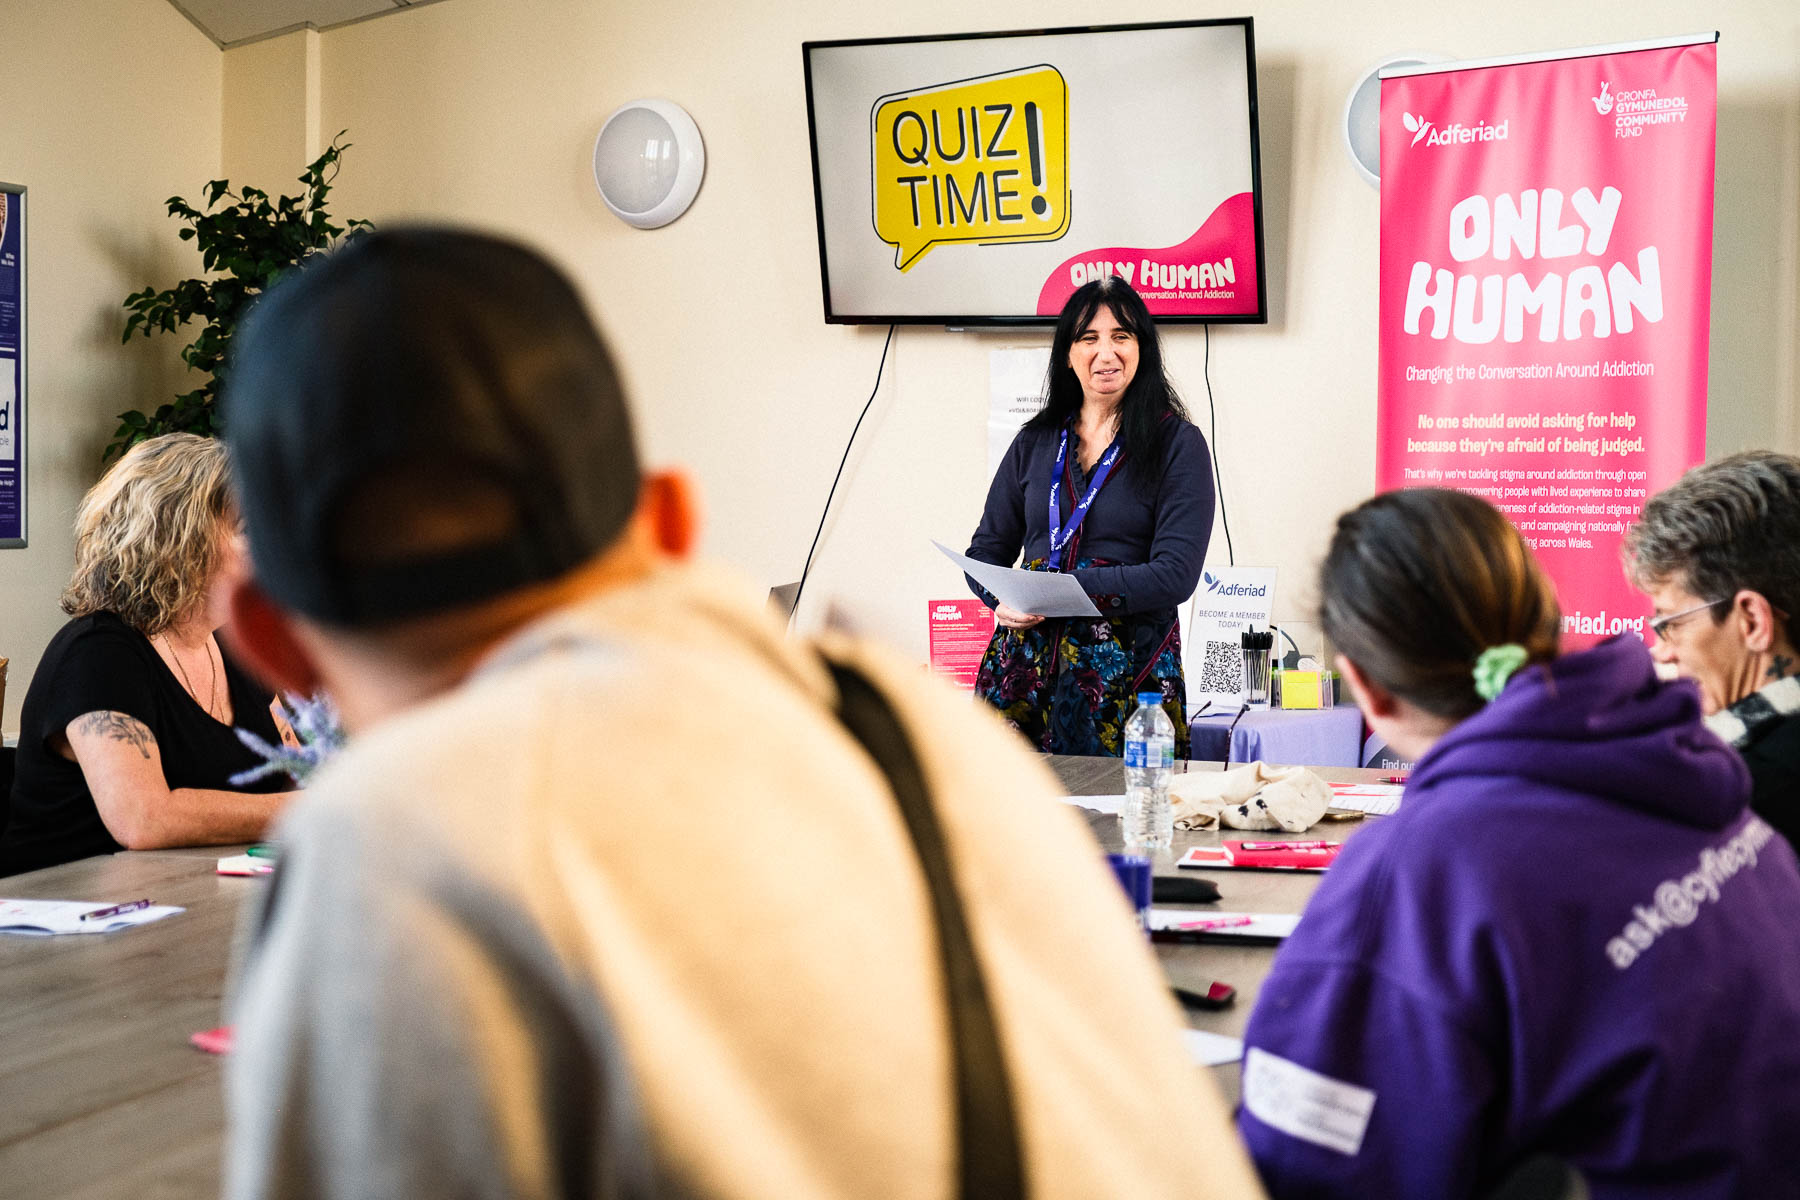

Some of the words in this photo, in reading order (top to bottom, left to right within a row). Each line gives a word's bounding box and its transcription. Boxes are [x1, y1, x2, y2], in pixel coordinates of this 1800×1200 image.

[1616, 89, 1656, 102] CRONFA
[1616, 97, 1688, 113] GYMUNEDOL
[1616, 111, 1687, 127] COMMUNITY
[892, 103, 1018, 166] QUIZ
[1426, 120, 1508, 147] Adferiad
[1615, 127, 1643, 138] FUND
[1449, 186, 1622, 262] ONLY
[1140, 257, 1236, 290] HUMAN
[1178, 291, 1202, 299] Around
[1204, 289, 1234, 299] Addiction
[1403, 246, 1664, 344] HUMAN
[1406, 365, 1453, 384] Changing
[1457, 364, 1475, 380] the
[1479, 363, 1552, 380] Conversation
[1556, 361, 1599, 378] Around
[1602, 360, 1654, 377] Addiction
[1418, 414, 1434, 429] No
[1436, 416, 1459, 429] one
[1462, 413, 1504, 429] should
[1506, 412, 1540, 429] avoid
[1542, 412, 1584, 432] asking
[1587, 411, 1608, 428] for
[1610, 411, 1636, 431] help
[1407, 437, 1456, 453] because
[1459, 437, 1504, 456] they're
[1507, 436, 1545, 453] afraid
[1547, 436, 1561, 453] of
[1564, 437, 1599, 456] being
[1600, 436, 1645, 456] judged.
[1404, 468, 1426, 479] That's
[1427, 468, 1443, 481] why
[1444, 469, 1467, 480] we're
[1468, 469, 1498, 482] tackling
[1499, 469, 1525, 482] stigma
[1526, 468, 1556, 480] around
[1556, 468, 1593, 480] addiction
[1595, 468, 1626, 483] through
[1627, 471, 1647, 483] open
[1504, 486, 1529, 500] people
[1531, 485, 1548, 496] with
[1550, 485, 1568, 497] lived
[1570, 486, 1612, 499] experience
[1614, 487, 1622, 497] to
[1624, 486, 1646, 497] share
[1493, 503, 1527, 513] areness
[1528, 502, 1537, 513] of
[1538, 502, 1605, 514] addiction-related
[1606, 504, 1631, 517] stigma
[1633, 503, 1640, 514] in
[1521, 520, 1536, 530] and
[1537, 521, 1586, 534] campaigning
[1588, 520, 1625, 535] nationally
[1540, 538, 1567, 548] across
[1568, 537, 1593, 549] Wales.
[1217, 584, 1266, 597] Adferiad
[1199, 610, 1227, 618] BECOME
[1235, 611, 1266, 620] MEMBER
[1562, 611, 1644, 642] riad.org
[1382, 759, 1399, 770] Find
